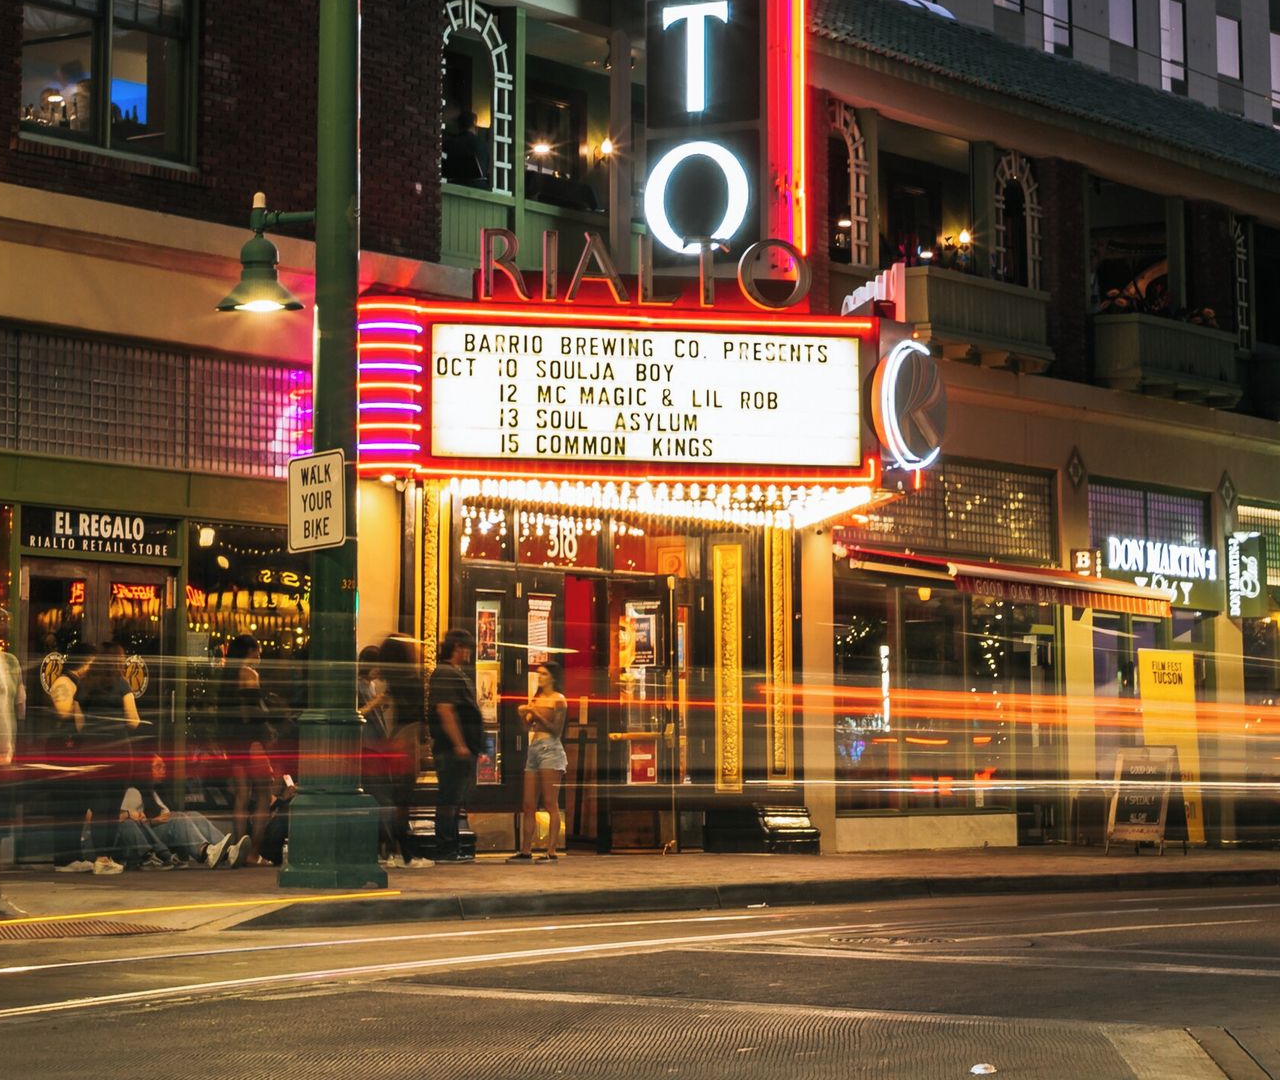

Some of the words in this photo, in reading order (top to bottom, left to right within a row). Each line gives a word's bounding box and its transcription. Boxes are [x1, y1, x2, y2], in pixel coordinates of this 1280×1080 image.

[480, 226, 812, 312] RIALTO
[464, 333, 543, 354] BARRIO
[561, 336, 653, 357] BREWING
[674, 339, 707, 359] CO.
[723, 341, 828, 363] PRESENTS
[437, 357, 476, 377] OCT
[498, 359, 518, 378] 10
[536, 360, 615, 380] SOULJA
[636, 363, 674, 382] BOY
[500, 384, 518, 402] 12
[537, 385, 566, 404] MC
[580, 386, 647, 406] MAGIC
[662, 389, 674, 407] &
[692, 390, 722, 408] LIL
[740, 391, 778, 410] ROB
[500, 408, 519, 428] 13
[536, 409, 588, 430] SOUL
[615, 412, 698, 432] ASYLUM
[501, 434, 519, 453] 15
[536, 435, 626, 455] COMMON
[652, 438, 713, 457] KINGS
[301, 463, 331, 487] WALK
[301, 490, 332, 512] YOUR
[55, 511, 72, 535] EL
[79, 513, 145, 541] REGALO
[304, 517, 330, 539] BIKE
[547, 517, 578, 559] 318
[29, 535, 75, 549] RIALTO
[82, 539, 124, 553] RETAIL
[132, 543, 168, 556] STORE
[1108, 537, 1145, 572] DON
[975, 580, 1003, 597] GOOD
[1010, 584, 1032, 601] OAK
[1038, 586, 1058, 603] BAR
[1229, 591, 1240, 616] DON
[1152, 661, 1166, 671] FILM
[1168, 661, 1182, 672] FEST
[1153, 671, 1183, 685] TUCSON
